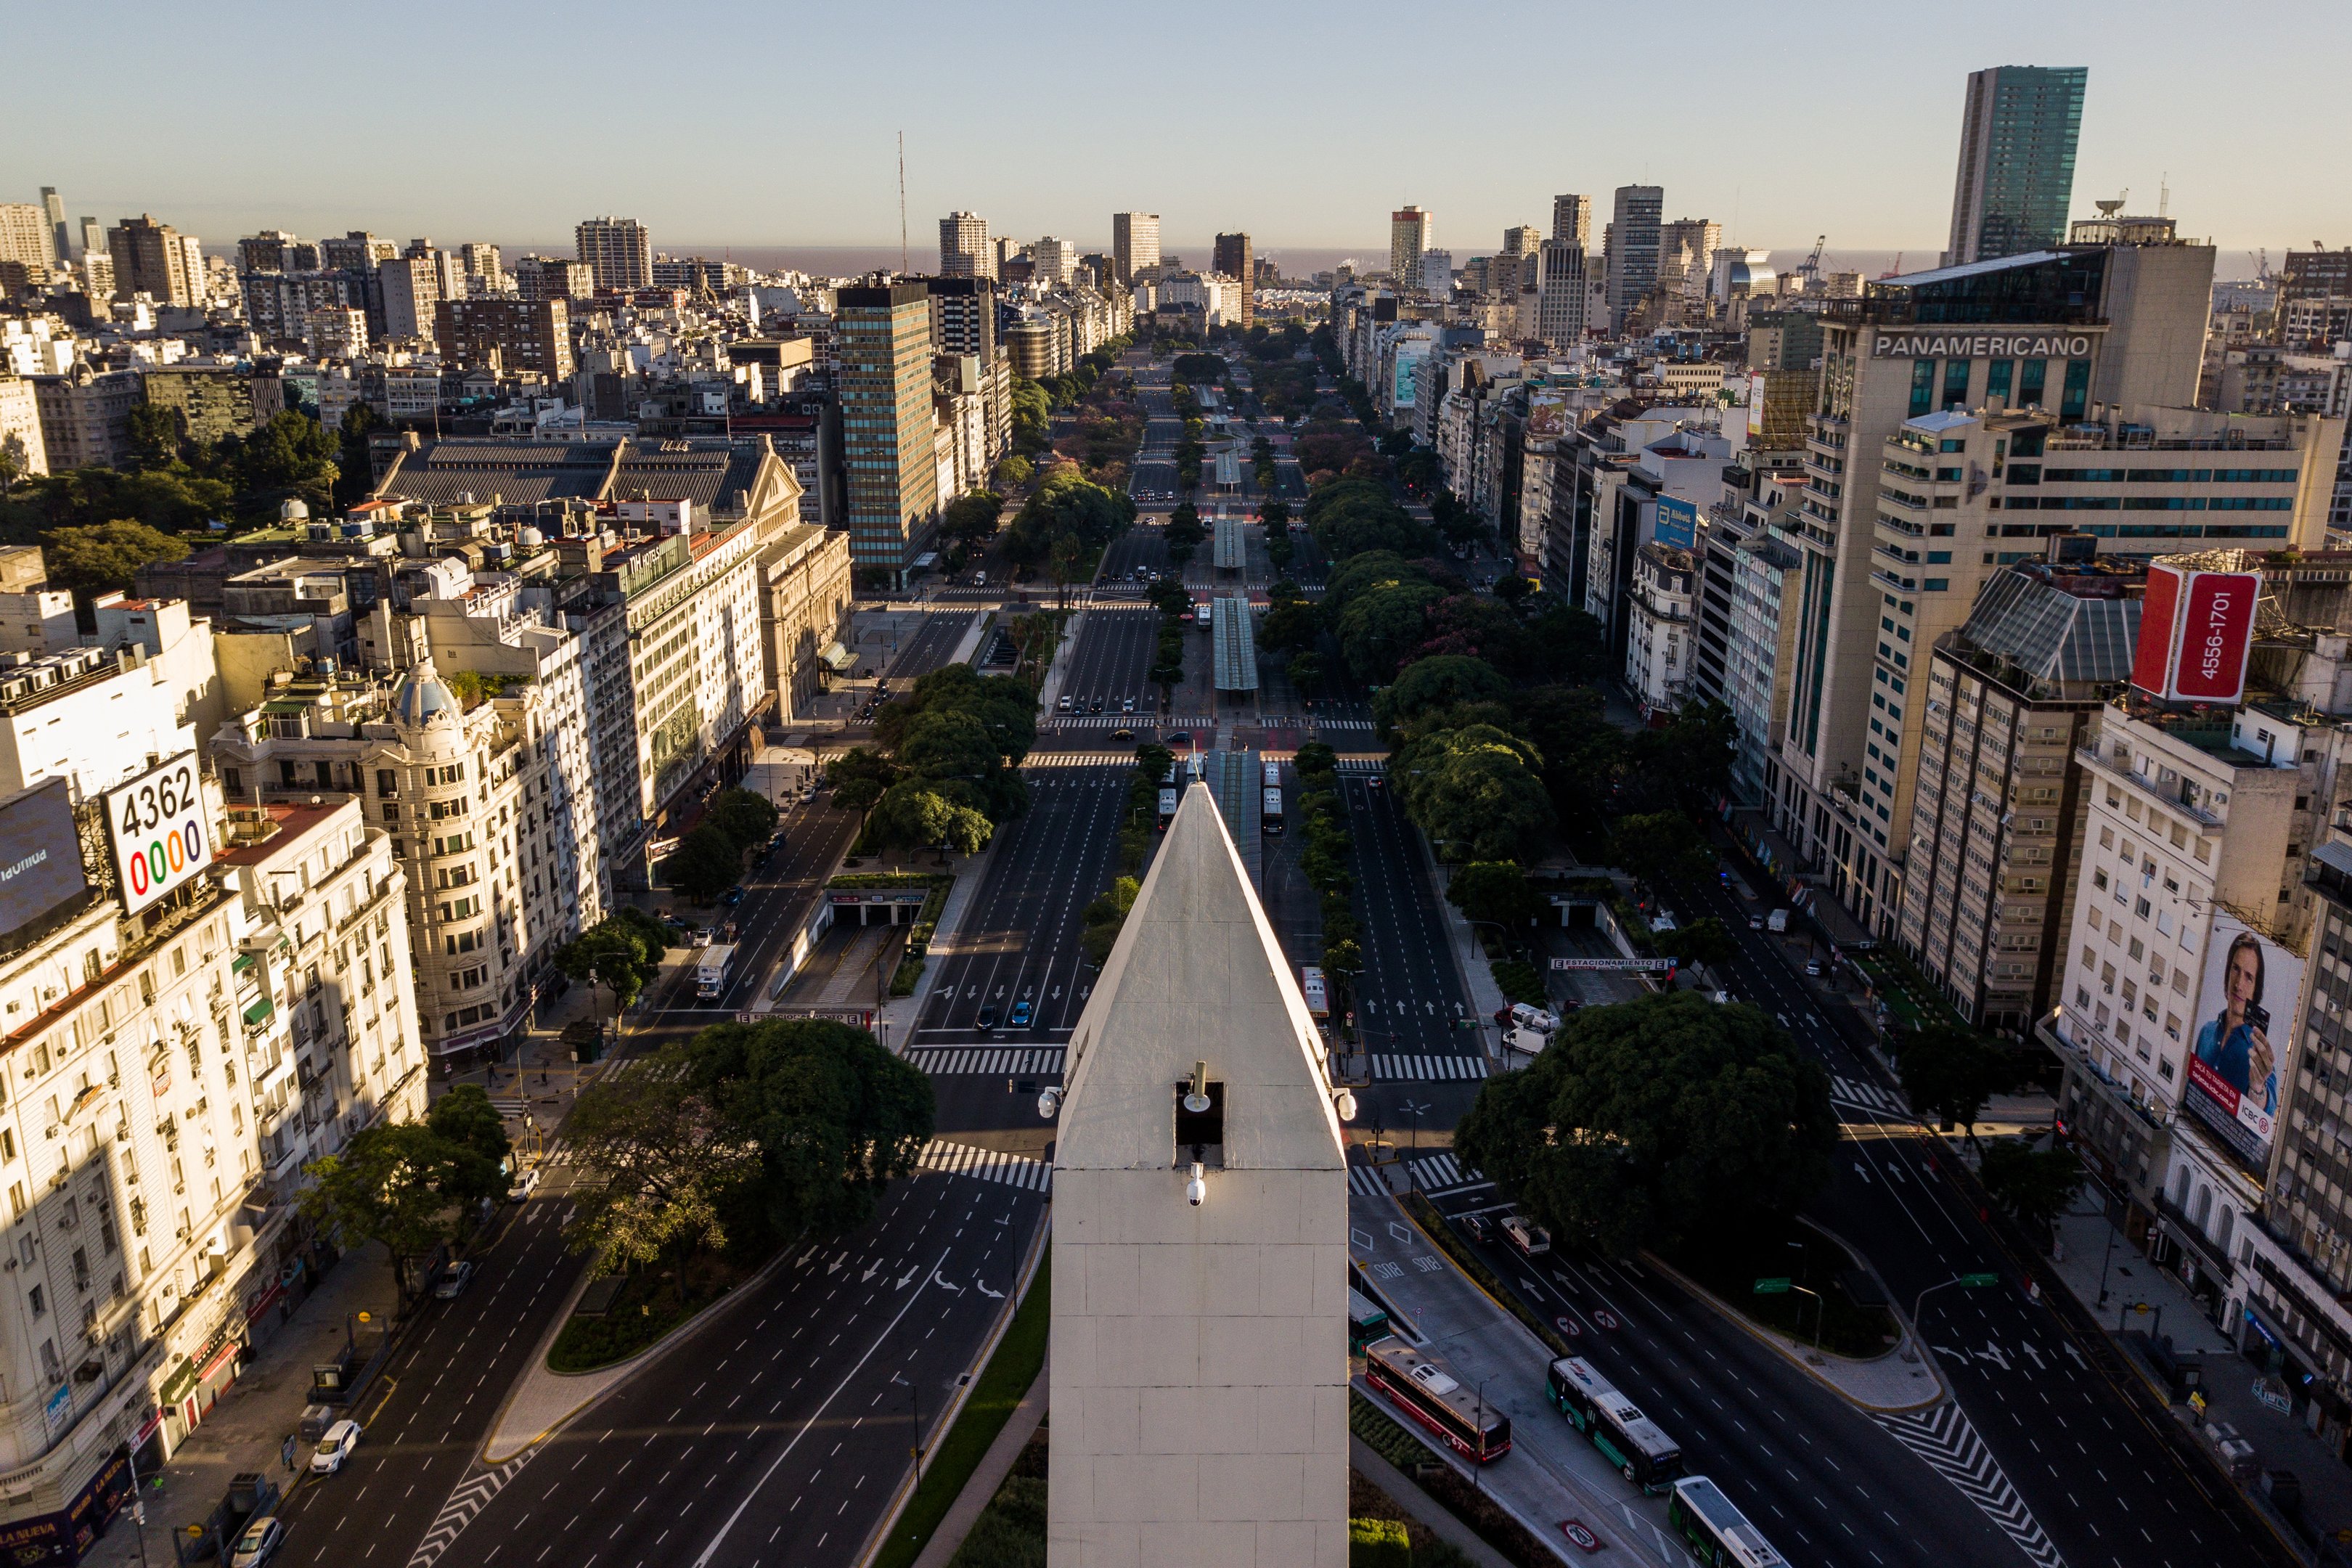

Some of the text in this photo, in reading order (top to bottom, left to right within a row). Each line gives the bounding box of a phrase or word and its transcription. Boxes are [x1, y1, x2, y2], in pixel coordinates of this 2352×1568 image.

[1875, 336, 2090, 356] PANAMERICANO
[642, 546, 660, 565] HOTELS
[2201, 592, 2231, 680] 4556-1701
[122, 766, 195, 837] 4362
[130, 820, 202, 896] 0000
[2212, 1075, 2229, 1095] TARJETA
[2242, 1104, 2258, 1124] ICBC
[1373, 1261, 1405, 1278] BUS
[1412, 1255, 1443, 1273] BUS
[1451, 1437, 1463, 1450] 67
[17, 1522, 57, 1540] NUEVA
[1569, 1527, 1593, 1545] 20
